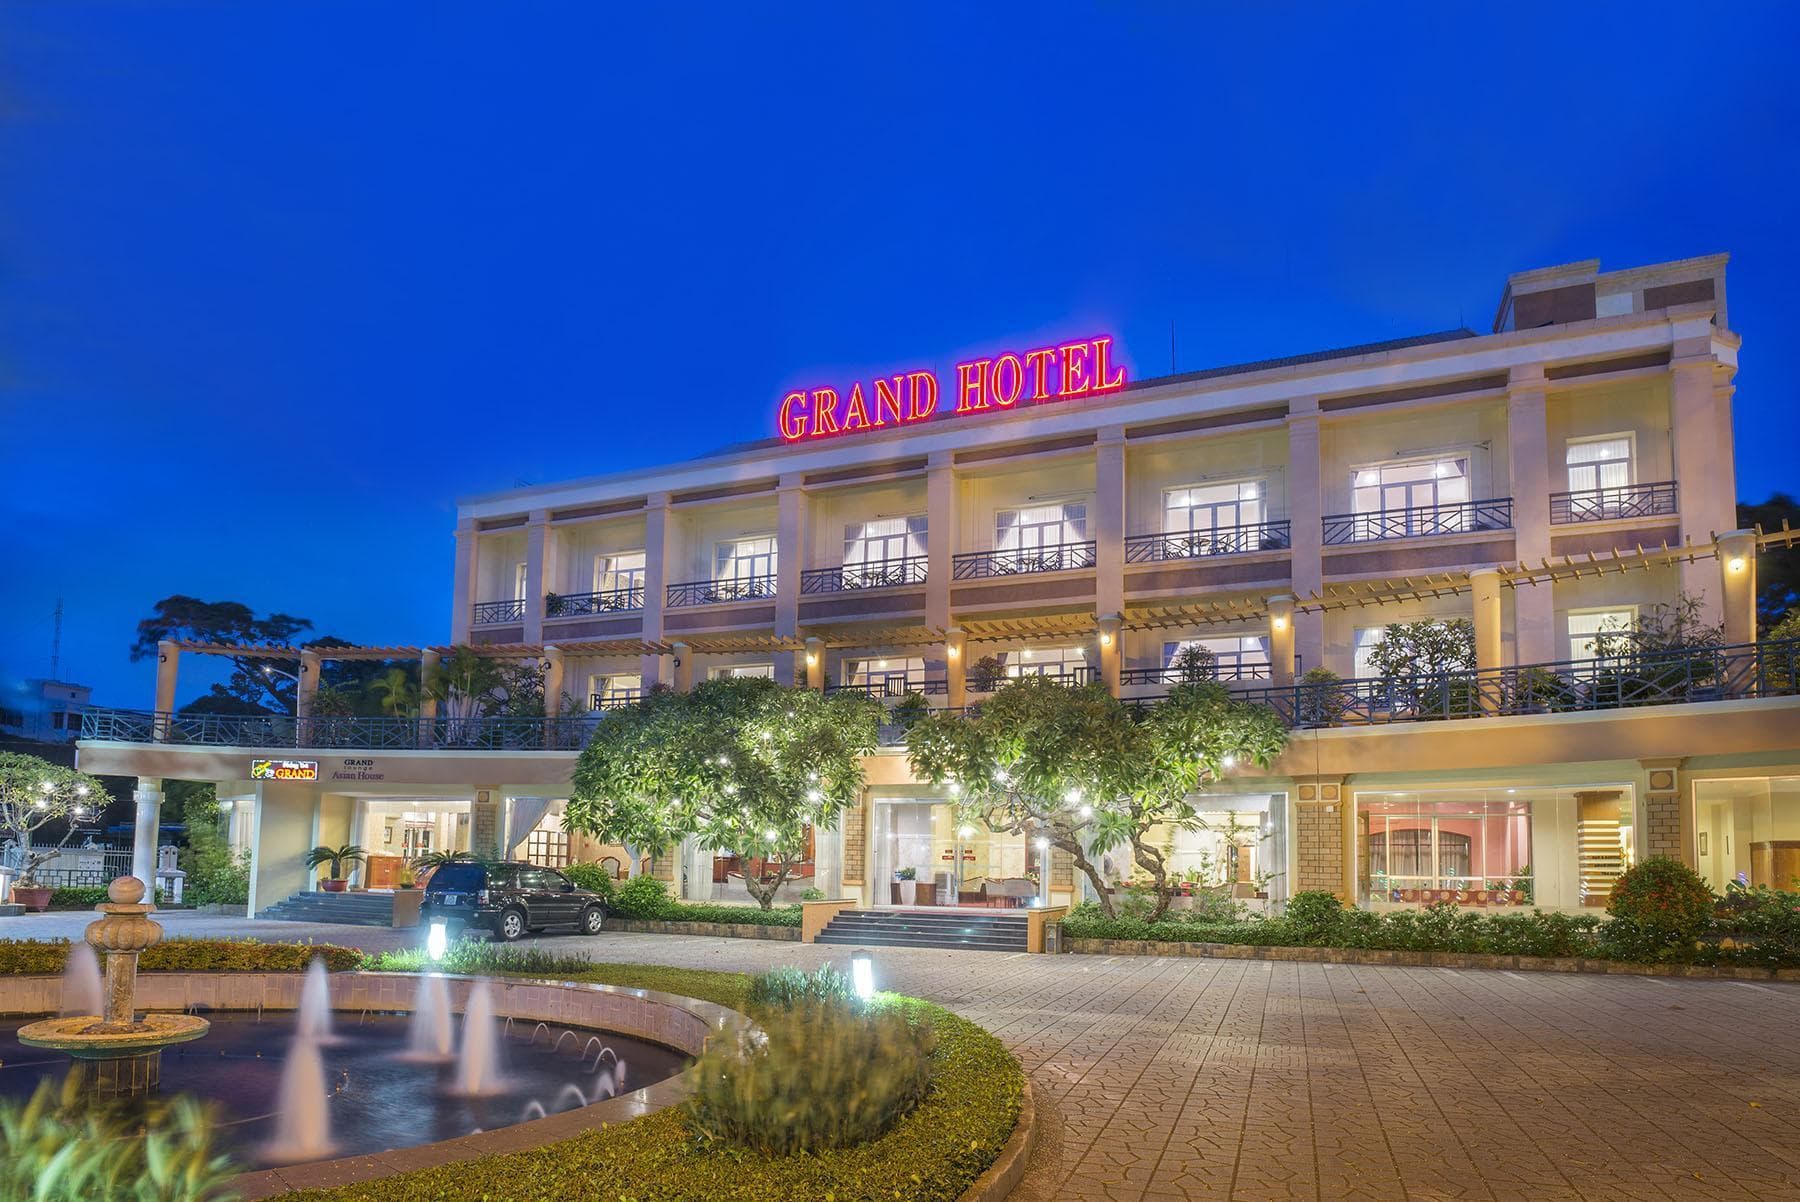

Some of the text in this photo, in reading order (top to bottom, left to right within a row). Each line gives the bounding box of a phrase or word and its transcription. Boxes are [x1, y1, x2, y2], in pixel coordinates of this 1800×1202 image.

[779, 338, 1124, 439] GRAND HOTEL
[275, 768, 315, 779] GRAND
[332, 771, 384, 780] Asian House
